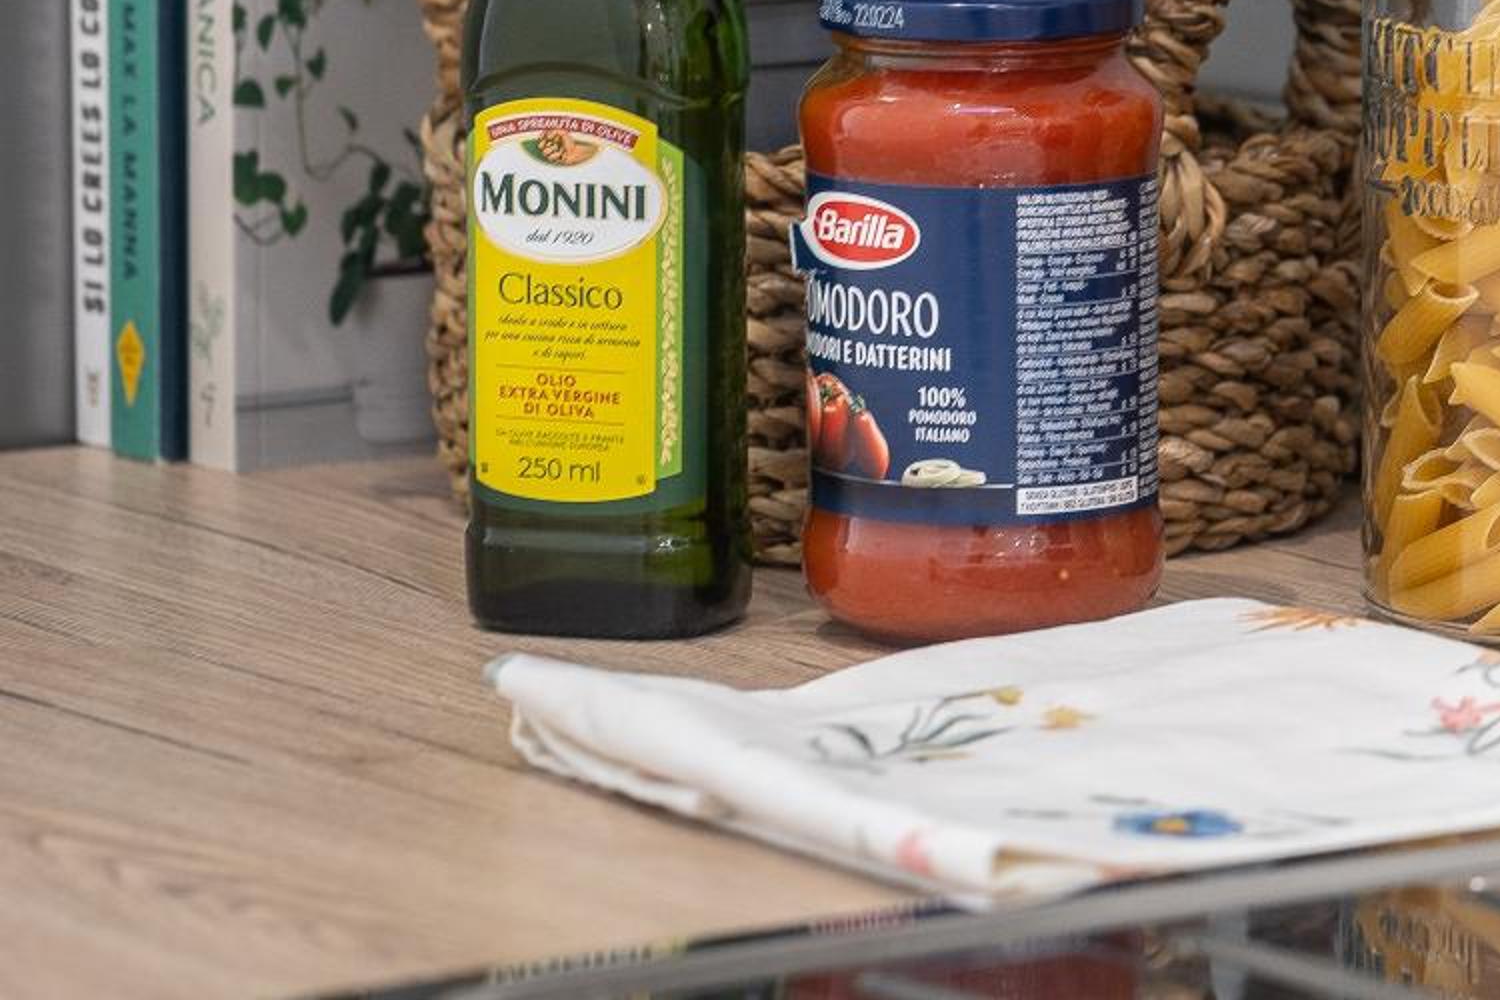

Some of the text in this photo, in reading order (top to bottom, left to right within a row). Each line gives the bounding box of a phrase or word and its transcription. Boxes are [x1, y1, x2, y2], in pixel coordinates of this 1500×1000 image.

[79, 51, 101, 89] LO
[123, 3, 138, 281] MAX LA MANNA
[81, 106, 103, 214] CREES
[481, 171, 648, 221] MONINI
[552, 229, 595, 245] 1920
[818, 208, 904, 249] Barilla
[82, 227, 104, 267] LO
[83, 280, 105, 314] SI
[499, 272, 623, 310] Classico
[806, 275, 940, 338] OMODORO
[843, 340, 853, 364] E
[855, 341, 952, 371] DATTERINI
[499, 385, 621, 405] EXTRA VERGINE
[535, 373, 577, 387] OLIO
[523, 401, 594, 418] DI OLIVA
[917, 385, 967, 408] 100%
[908, 408, 977, 425] POMODORO
[915, 426, 971, 443] ITALIANO
[518, 456, 601, 484] 250 ml
